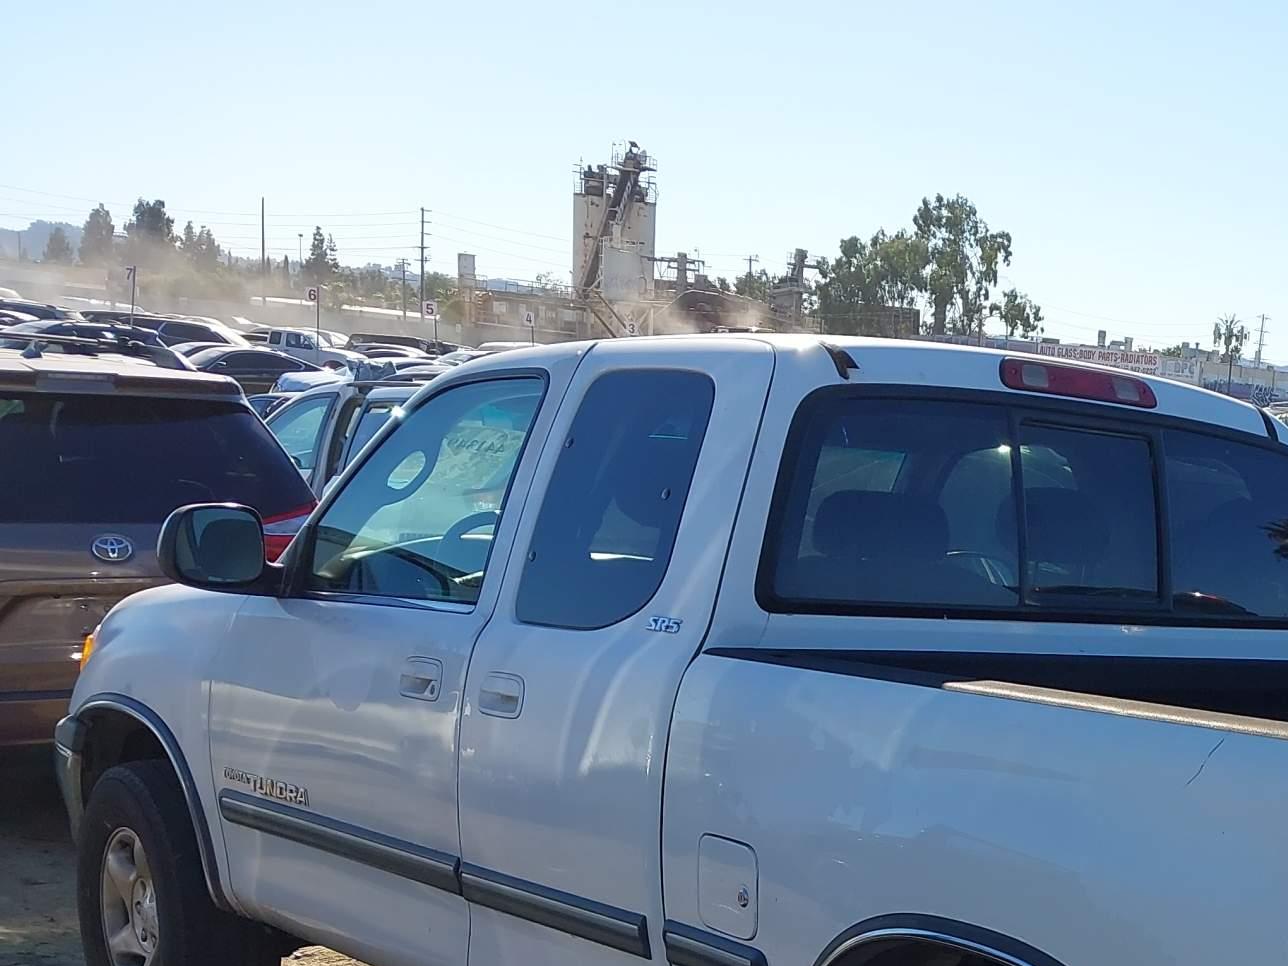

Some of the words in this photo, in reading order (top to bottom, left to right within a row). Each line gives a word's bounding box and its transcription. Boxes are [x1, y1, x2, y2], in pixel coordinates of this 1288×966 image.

[125, 267, 133, 280] 7
[308, 289, 317, 301] 6
[425, 303, 434, 315] 5
[525, 312, 532, 324] 4
[628, 323, 636, 334] 3
[1040, 345, 1056, 356] AUTO
[645, 616, 683, 634] SR5
[249, 774, 310, 807] TUNDRA
